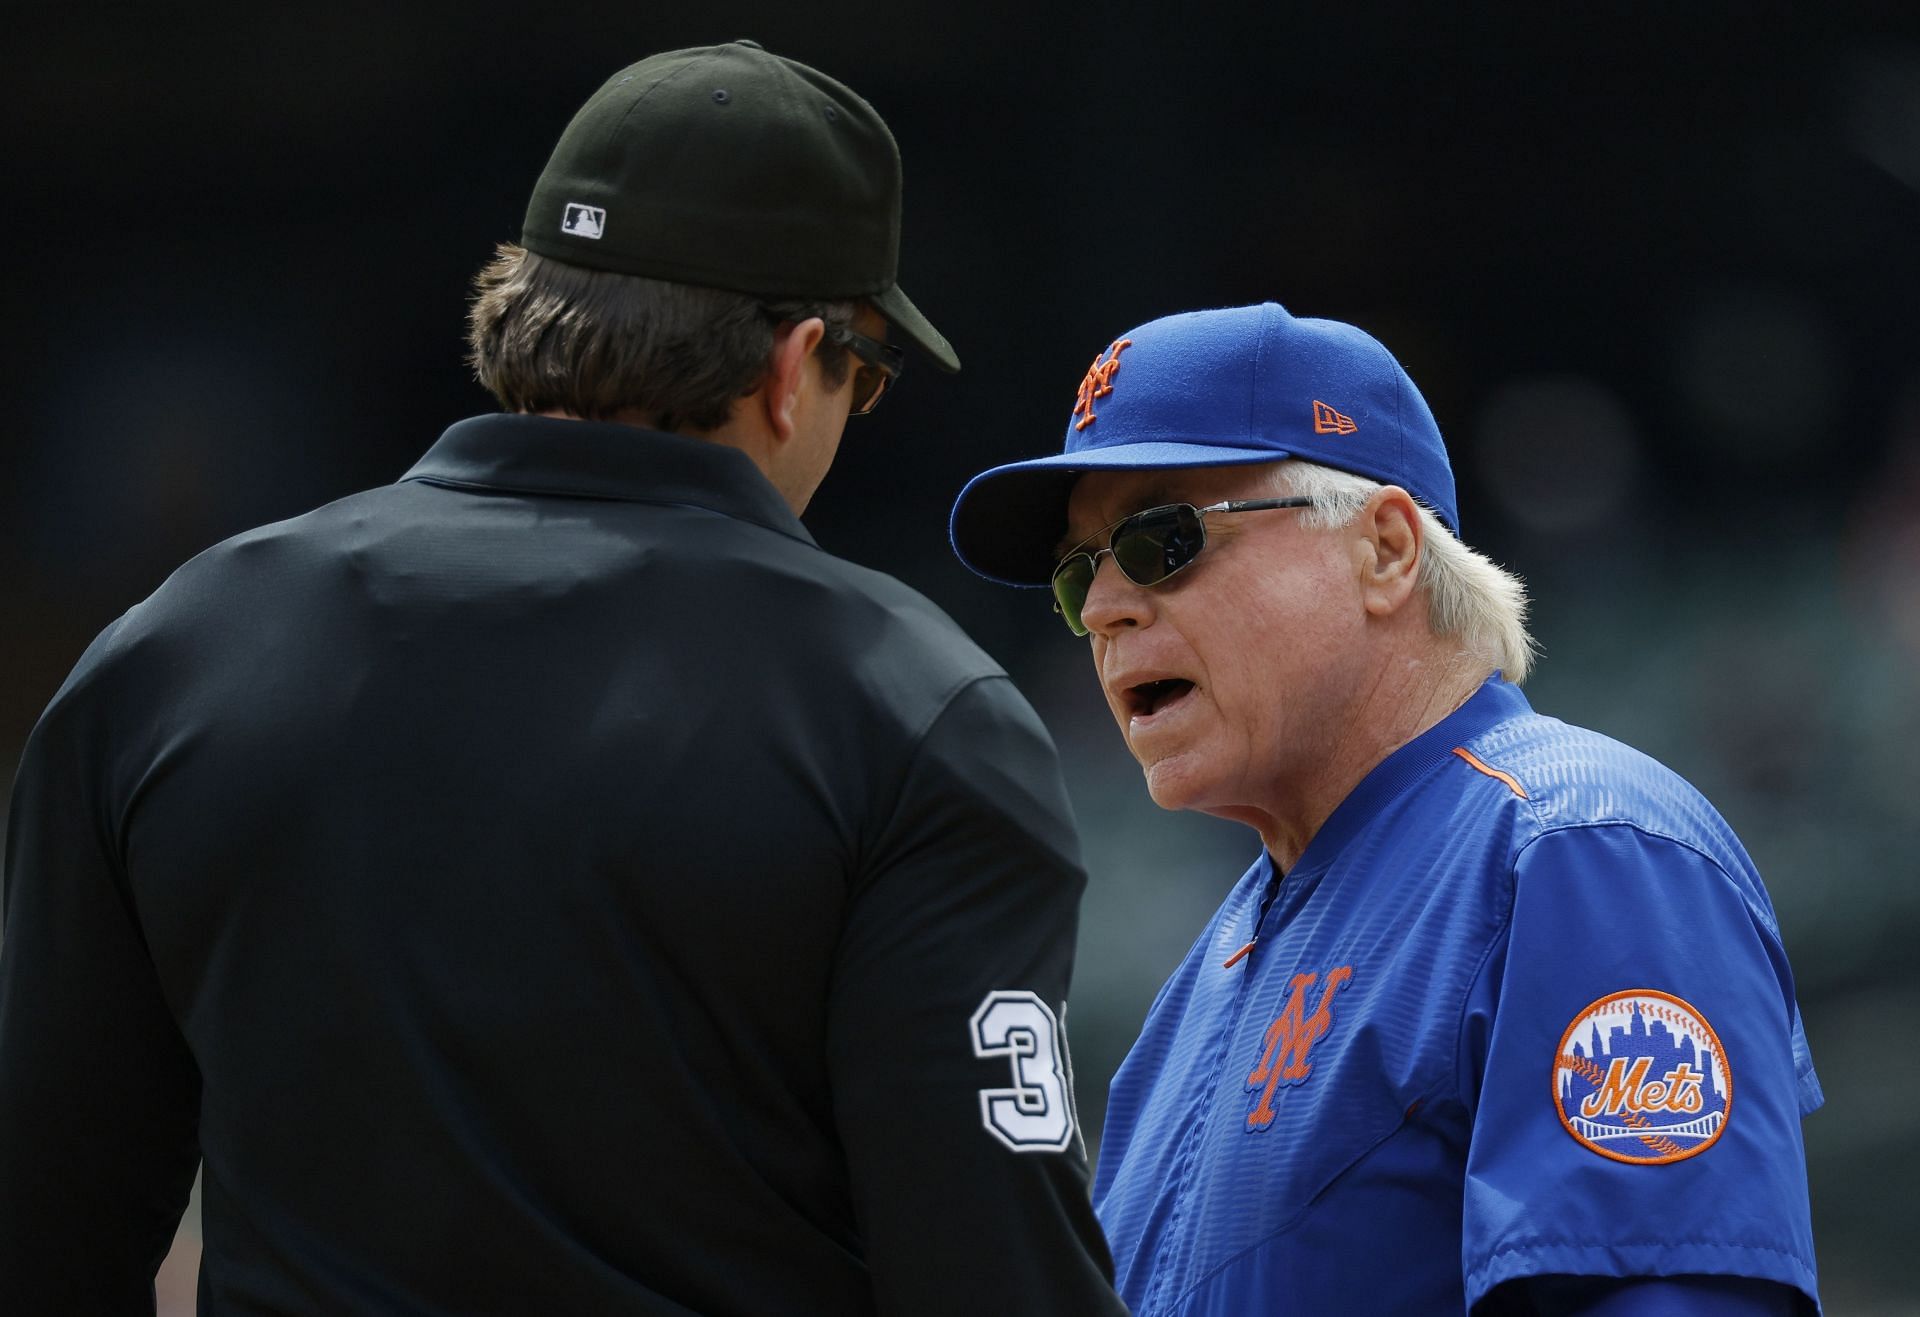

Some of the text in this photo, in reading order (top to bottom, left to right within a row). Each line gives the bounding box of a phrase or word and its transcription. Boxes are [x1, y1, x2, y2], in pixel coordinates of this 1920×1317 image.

[969, 990, 1087, 1160] 3
[1247, 966, 1352, 1126] NY
[1581, 1056, 1704, 1118] Mets
